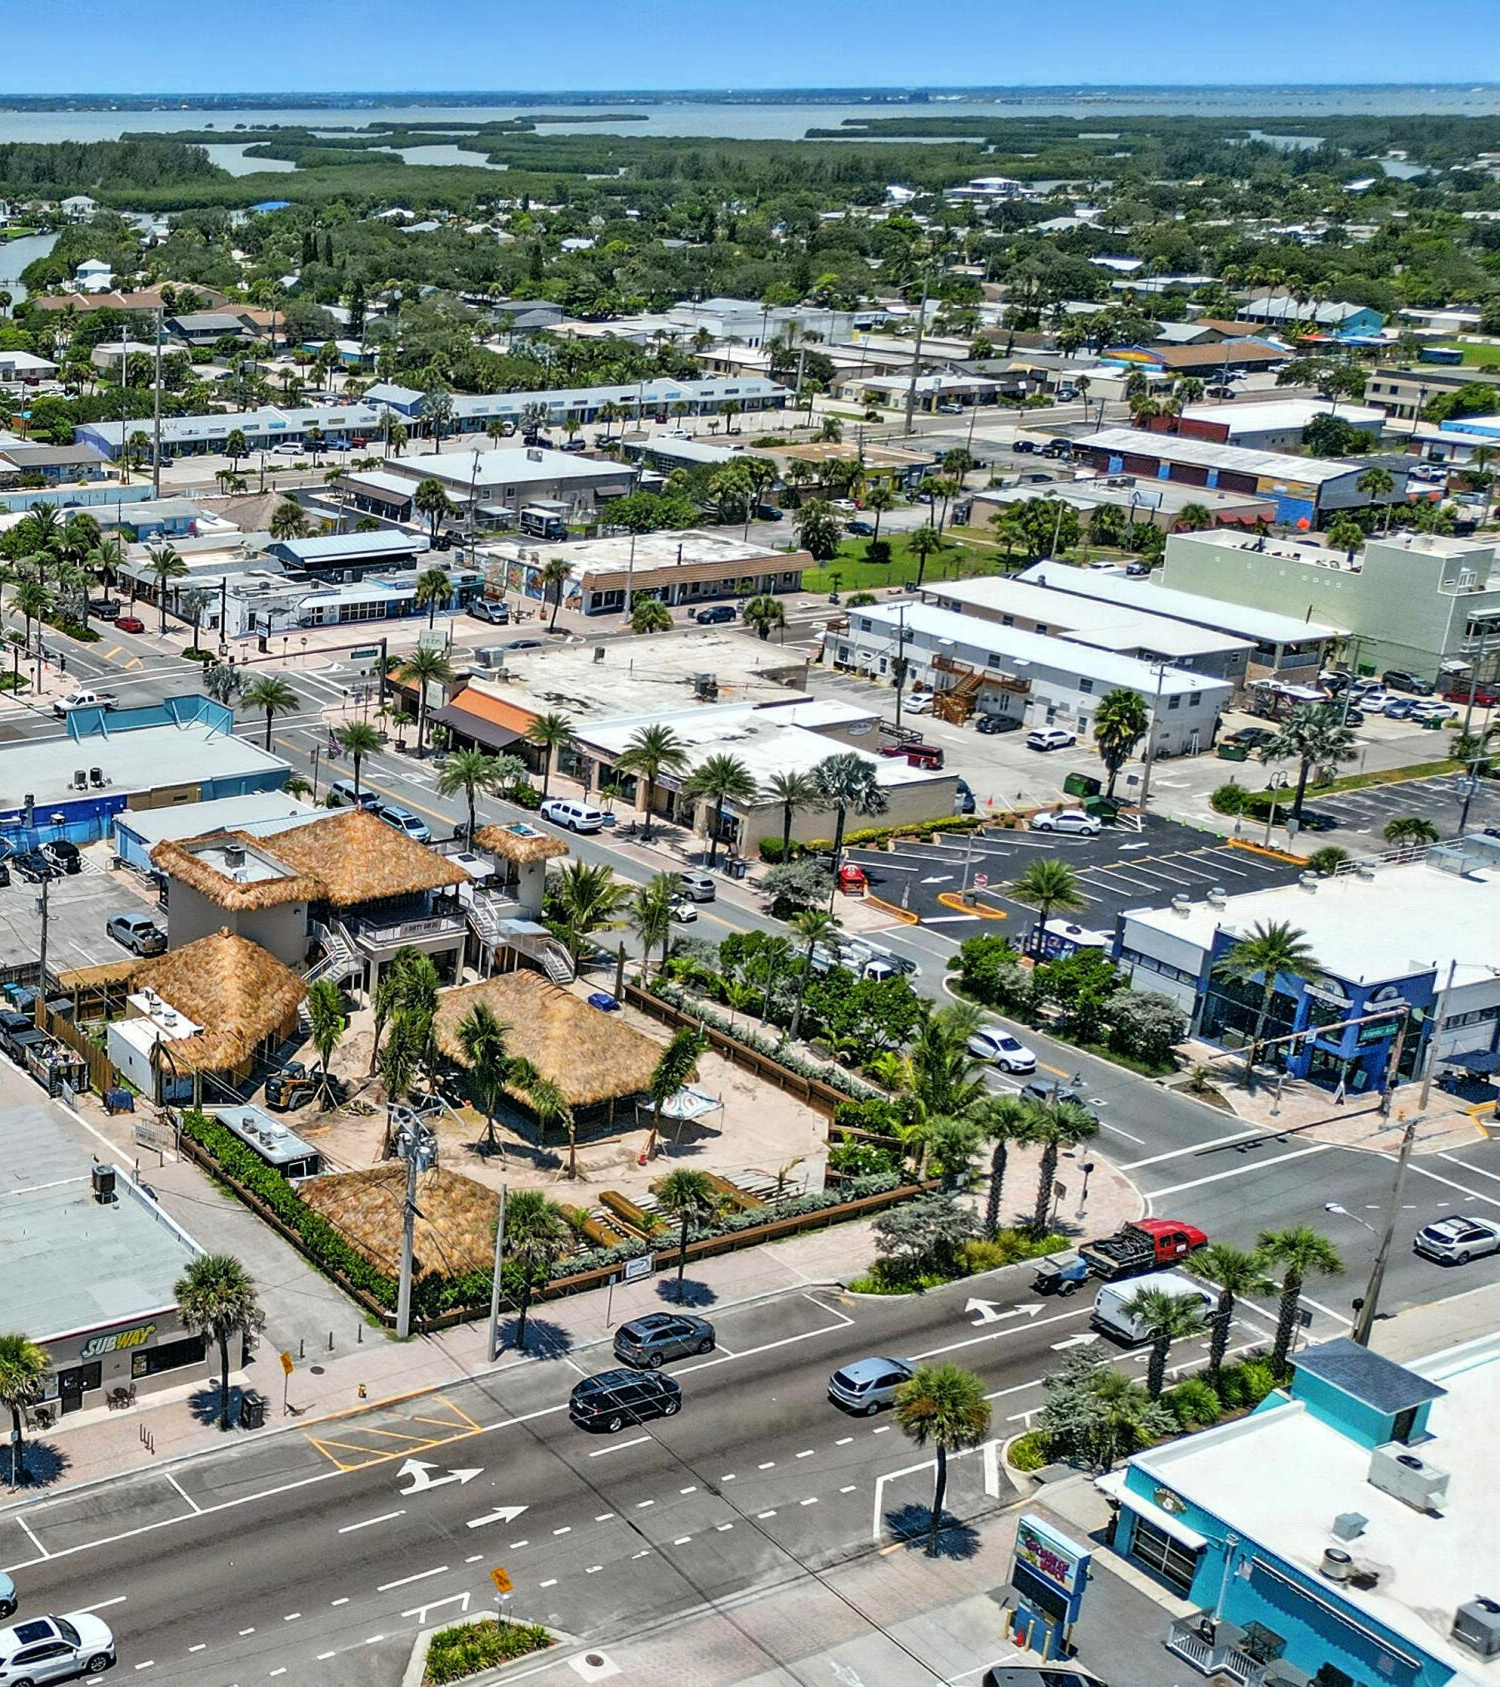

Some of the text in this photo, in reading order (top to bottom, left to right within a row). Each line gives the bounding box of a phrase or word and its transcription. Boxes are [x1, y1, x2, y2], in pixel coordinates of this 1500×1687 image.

[82, 1323, 157, 1358] SUBWAY
[1154, 1487, 1188, 1511] CATEGORY
[1162, 1497, 1174, 1510] 5
